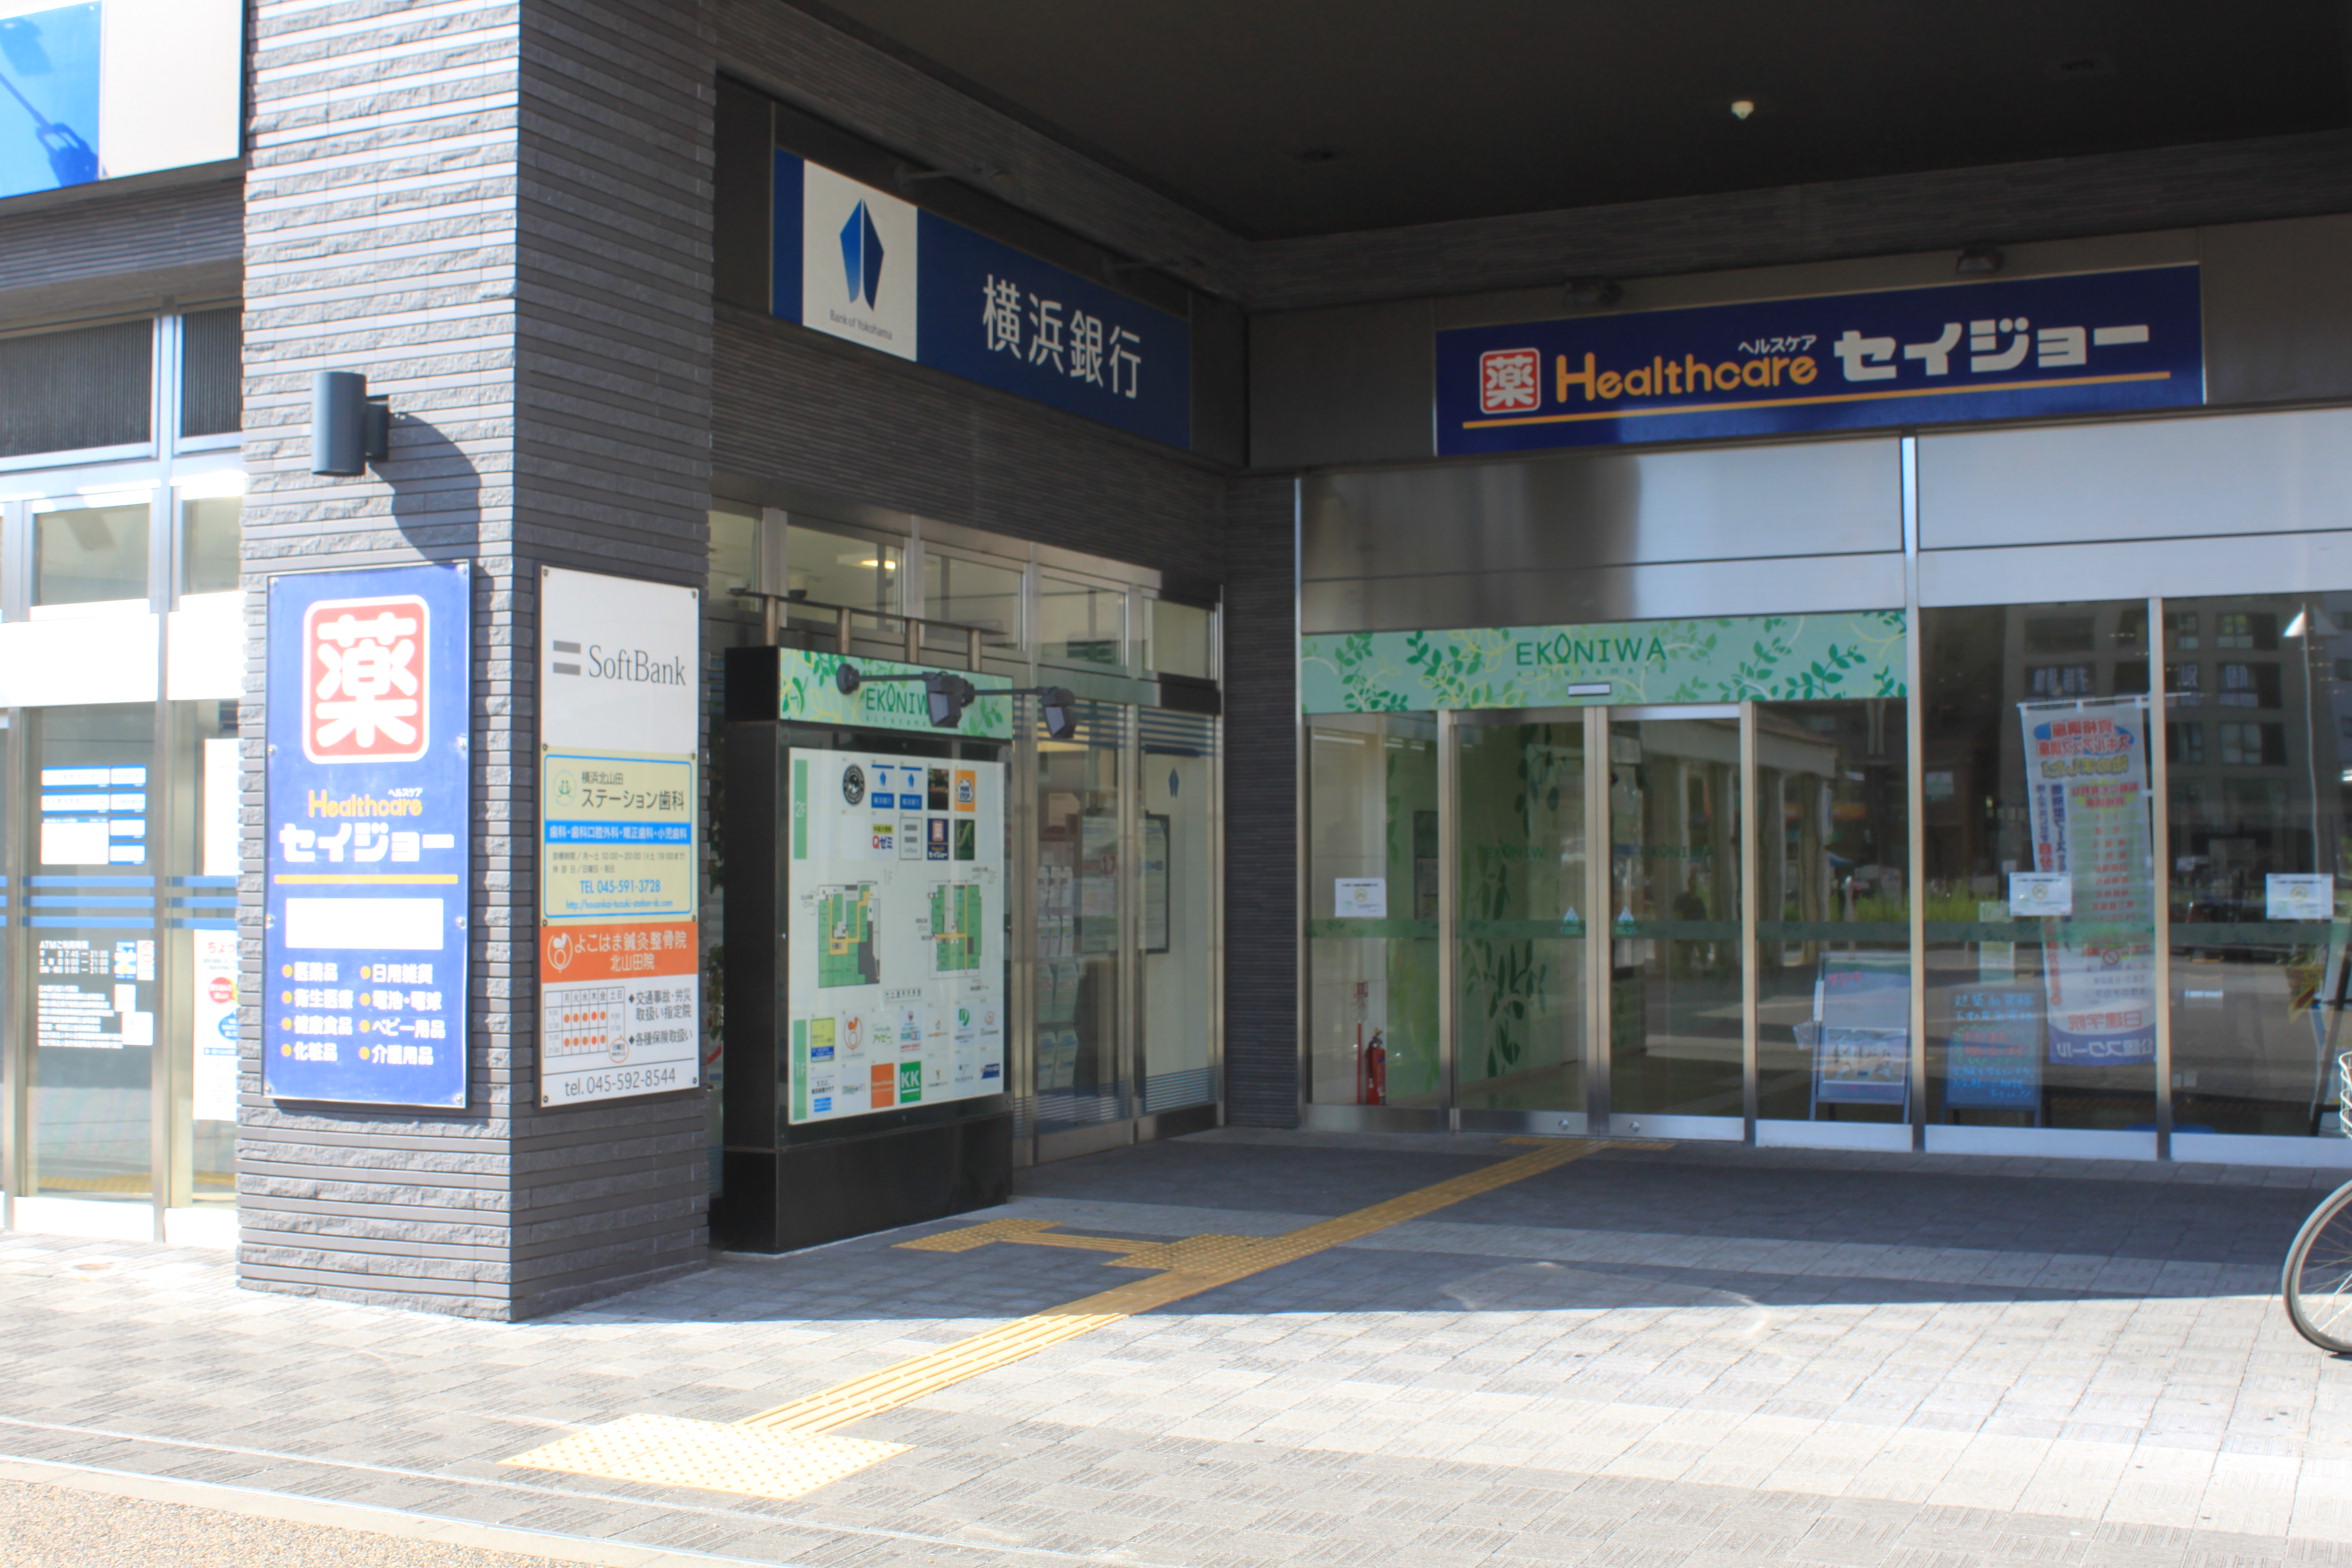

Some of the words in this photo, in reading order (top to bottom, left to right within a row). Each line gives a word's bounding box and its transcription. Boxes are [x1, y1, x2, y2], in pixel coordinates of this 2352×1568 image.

[982, 273, 1141, 400] 横浜銀行
[1737, 334, 1818, 355] ヘルスケア
[1833, 316, 2149, 382] セイジョー
[1485, 354, 1535, 408] 薬
[1555, 351, 1818, 404] Healthcare
[588, 644, 687, 687] SoftBank
[1515, 632, 1668, 666] EKONIWA
[315, 611, 418, 748] 薬
[865, 683, 930, 716] EKONIW
[581, 771, 624, 786] 横浜北山田
[308, 789, 423, 818] Healthcare
[581, 788, 685, 812] ステーション歯科
[279, 822, 455, 862] セイジョー
[580, 880, 595, 894] TEL
[597, 879, 662, 894] 045-591-3728
[610, 952, 656, 973] 北山田院
[371, 1017, 447, 1039] ベビー用品
[901, 1070, 920, 1089] KK
